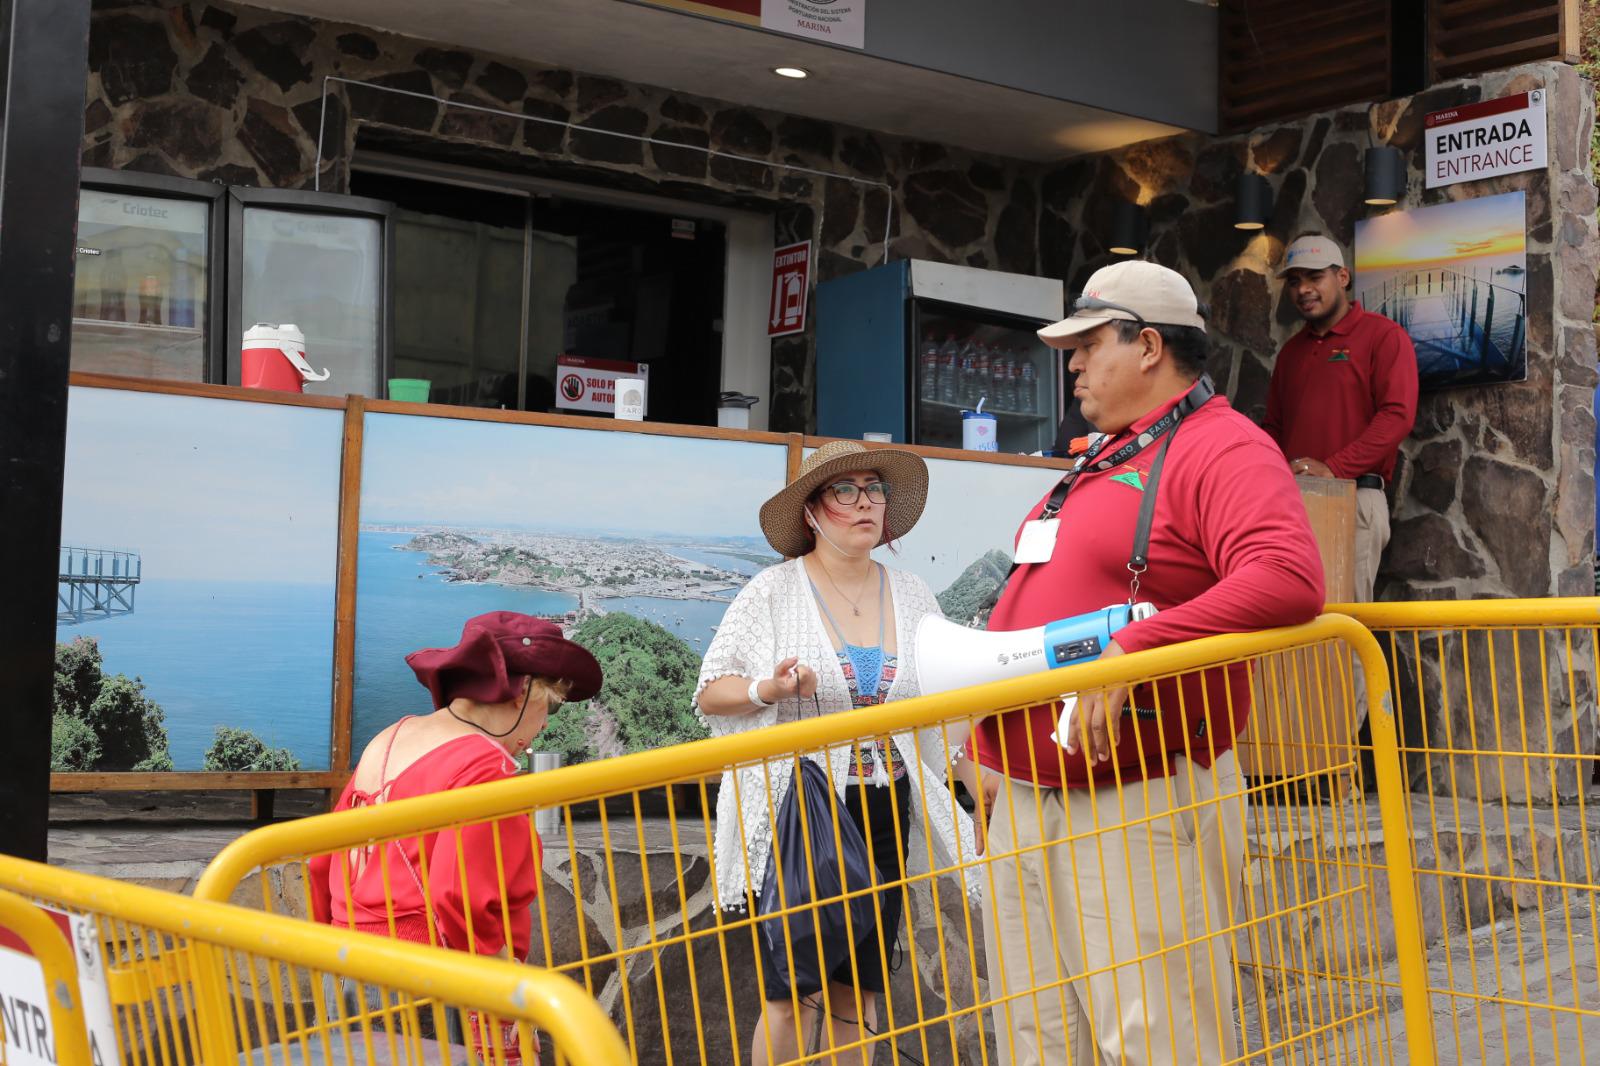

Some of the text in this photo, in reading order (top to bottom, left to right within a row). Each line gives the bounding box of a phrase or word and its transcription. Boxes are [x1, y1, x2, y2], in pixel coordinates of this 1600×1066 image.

[788, 5, 842, 23] PORTUARIO NACIONAL
[830, 7, 852, 15] SISTEMA
[797, 19, 832, 34] MARINA
[1436, 119, 1533, 155] ENTRADA
[1437, 144, 1534, 179] ENTRANCE
[775, 250, 807, 268] EXTINTOR
[586, 378, 606, 389] SOLO
[1149, 416, 1170, 436] FARO
[1109, 444, 1134, 464] FARO
[1012, 648, 1043, 661] Steren
